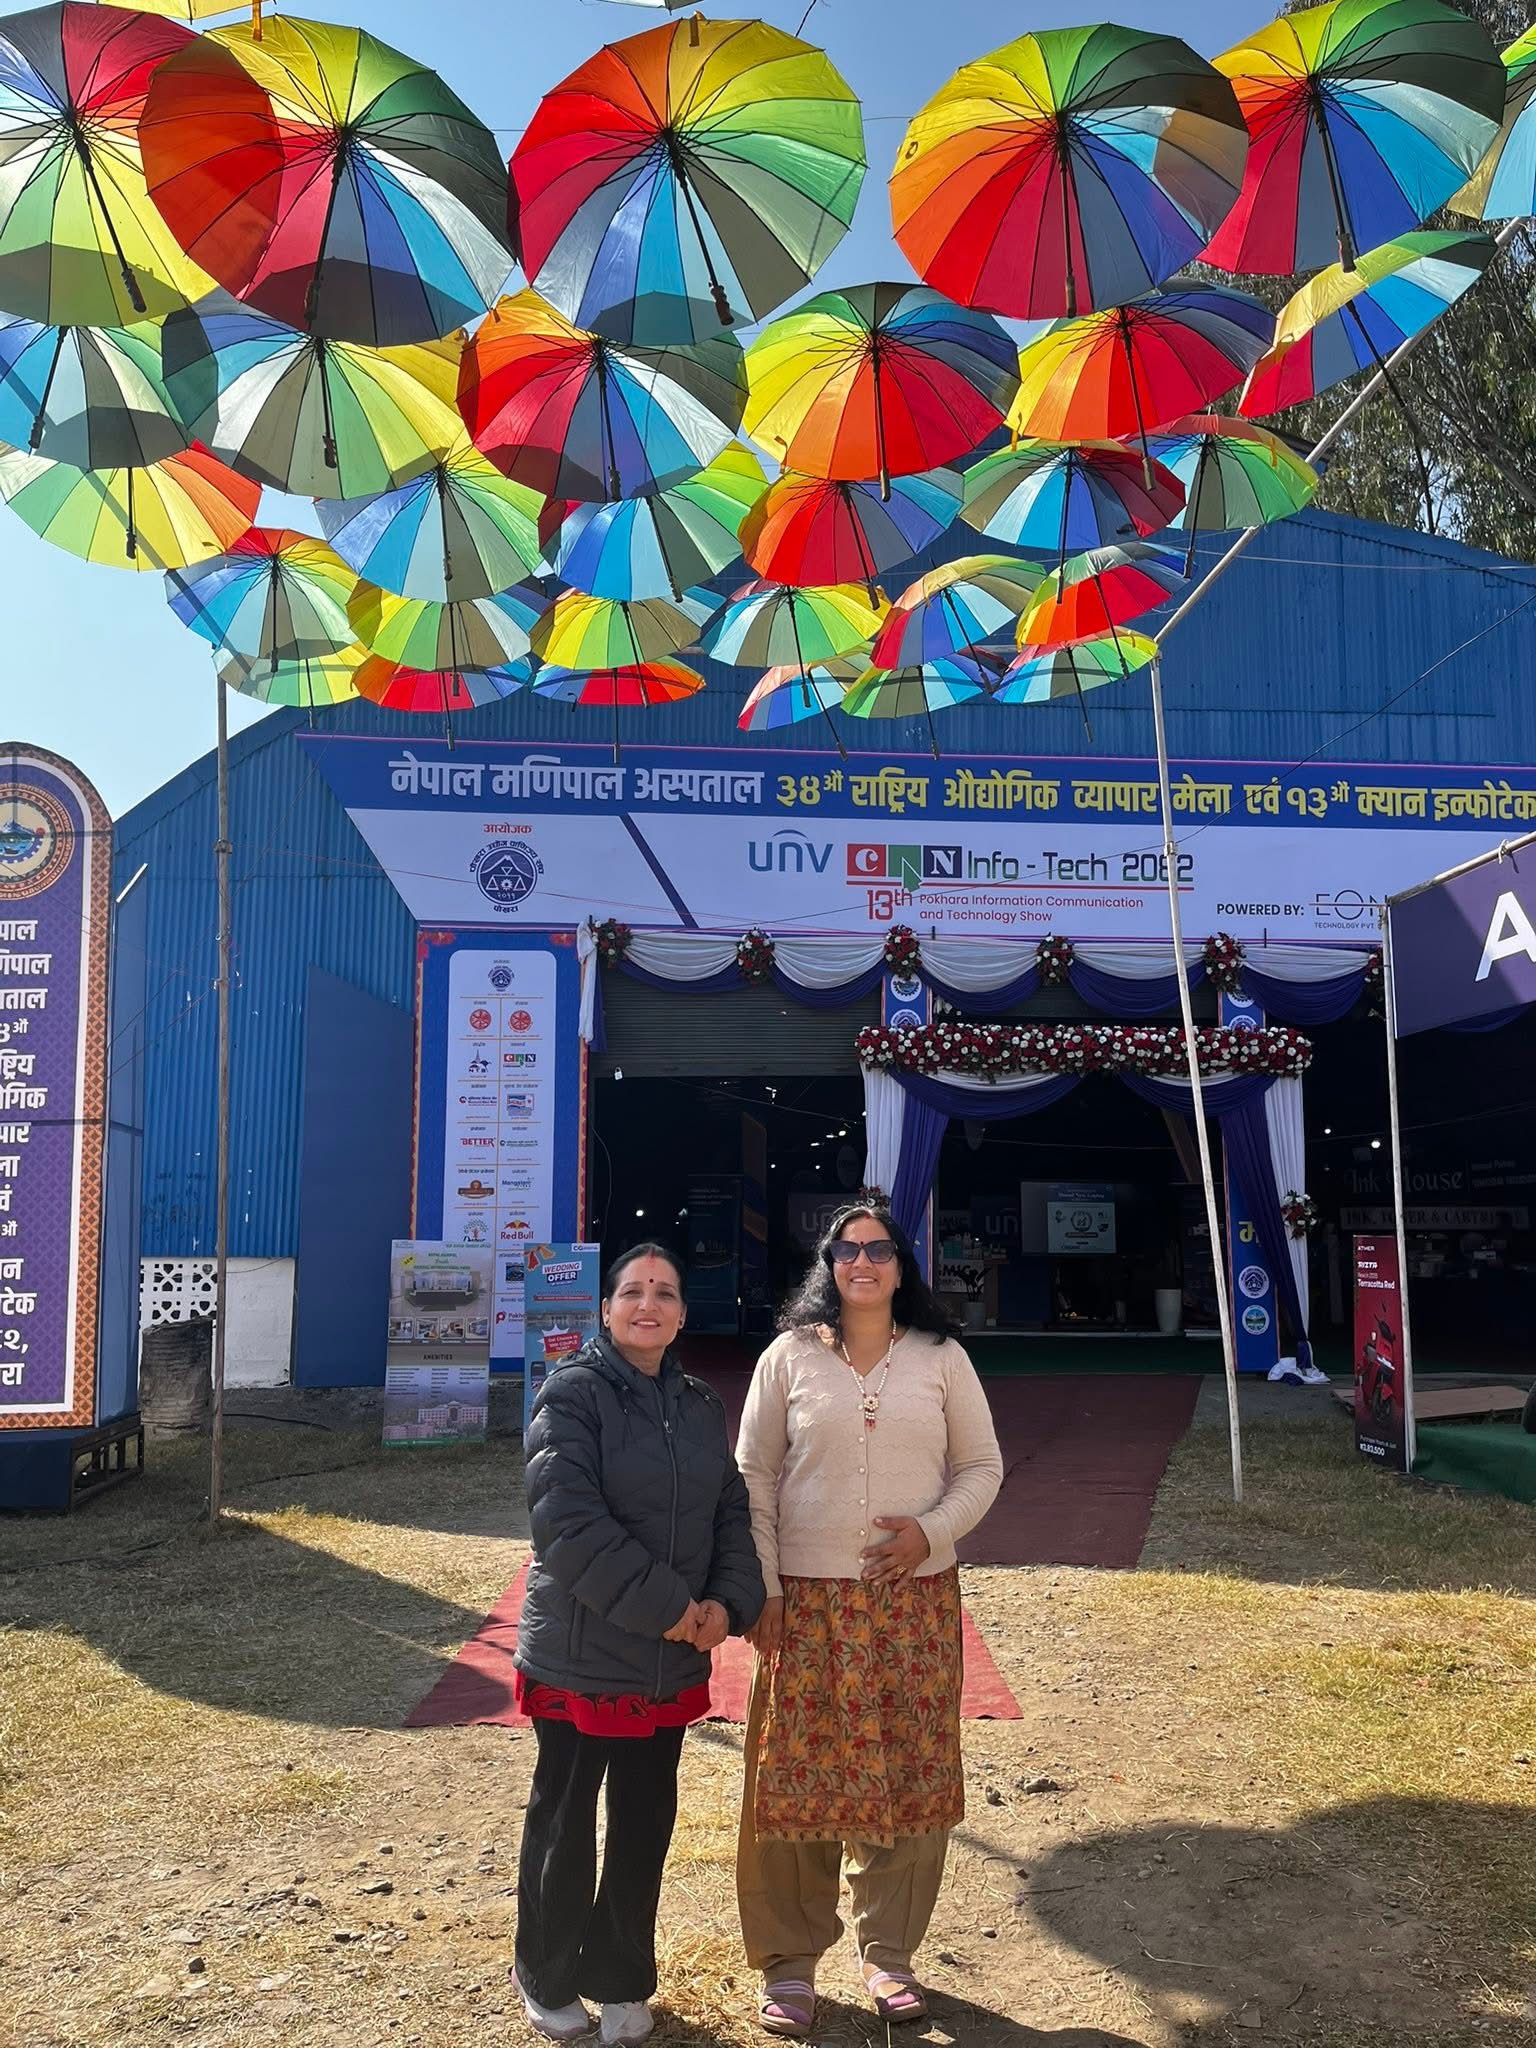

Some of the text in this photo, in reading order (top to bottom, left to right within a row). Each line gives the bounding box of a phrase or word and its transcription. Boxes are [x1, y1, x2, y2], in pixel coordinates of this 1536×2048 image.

[388, 750, 485, 797] नेपाल
[489, 754, 627, 801] मणिपाल
[634, 769, 764, 804] अस्पताल
[850, 767, 929, 813] राष्ट्रिय
[944, 769, 1060, 810] औद्योगिक
[1071, 780, 1159, 812] व्यापार
[1170, 773, 1233, 815] मेला
[1243, 776, 1282, 816] एवं
[1355, 786, 1428, 818] क्यान
[483, 823, 532, 833] आयोजक
[968, 850, 1019, 880] Info
[1043, 852, 1108, 881] Tech
[867, 889, 1144, 920] 13th Pokhara Information Communication
[1216, 903, 1280, 916] POWERED
[1283, 904, 1304, 916] BY:
[919, 909, 1053, 924] and Technology Show
[461, 1138, 494, 1147] BETTER
[501, 1231, 533, 1240] Red Bull
[543, 1262, 580, 1273] WEDDING
[547, 1272, 577, 1281] OFFER
[1357, 1279, 1395, 1289] Terracotta Red
